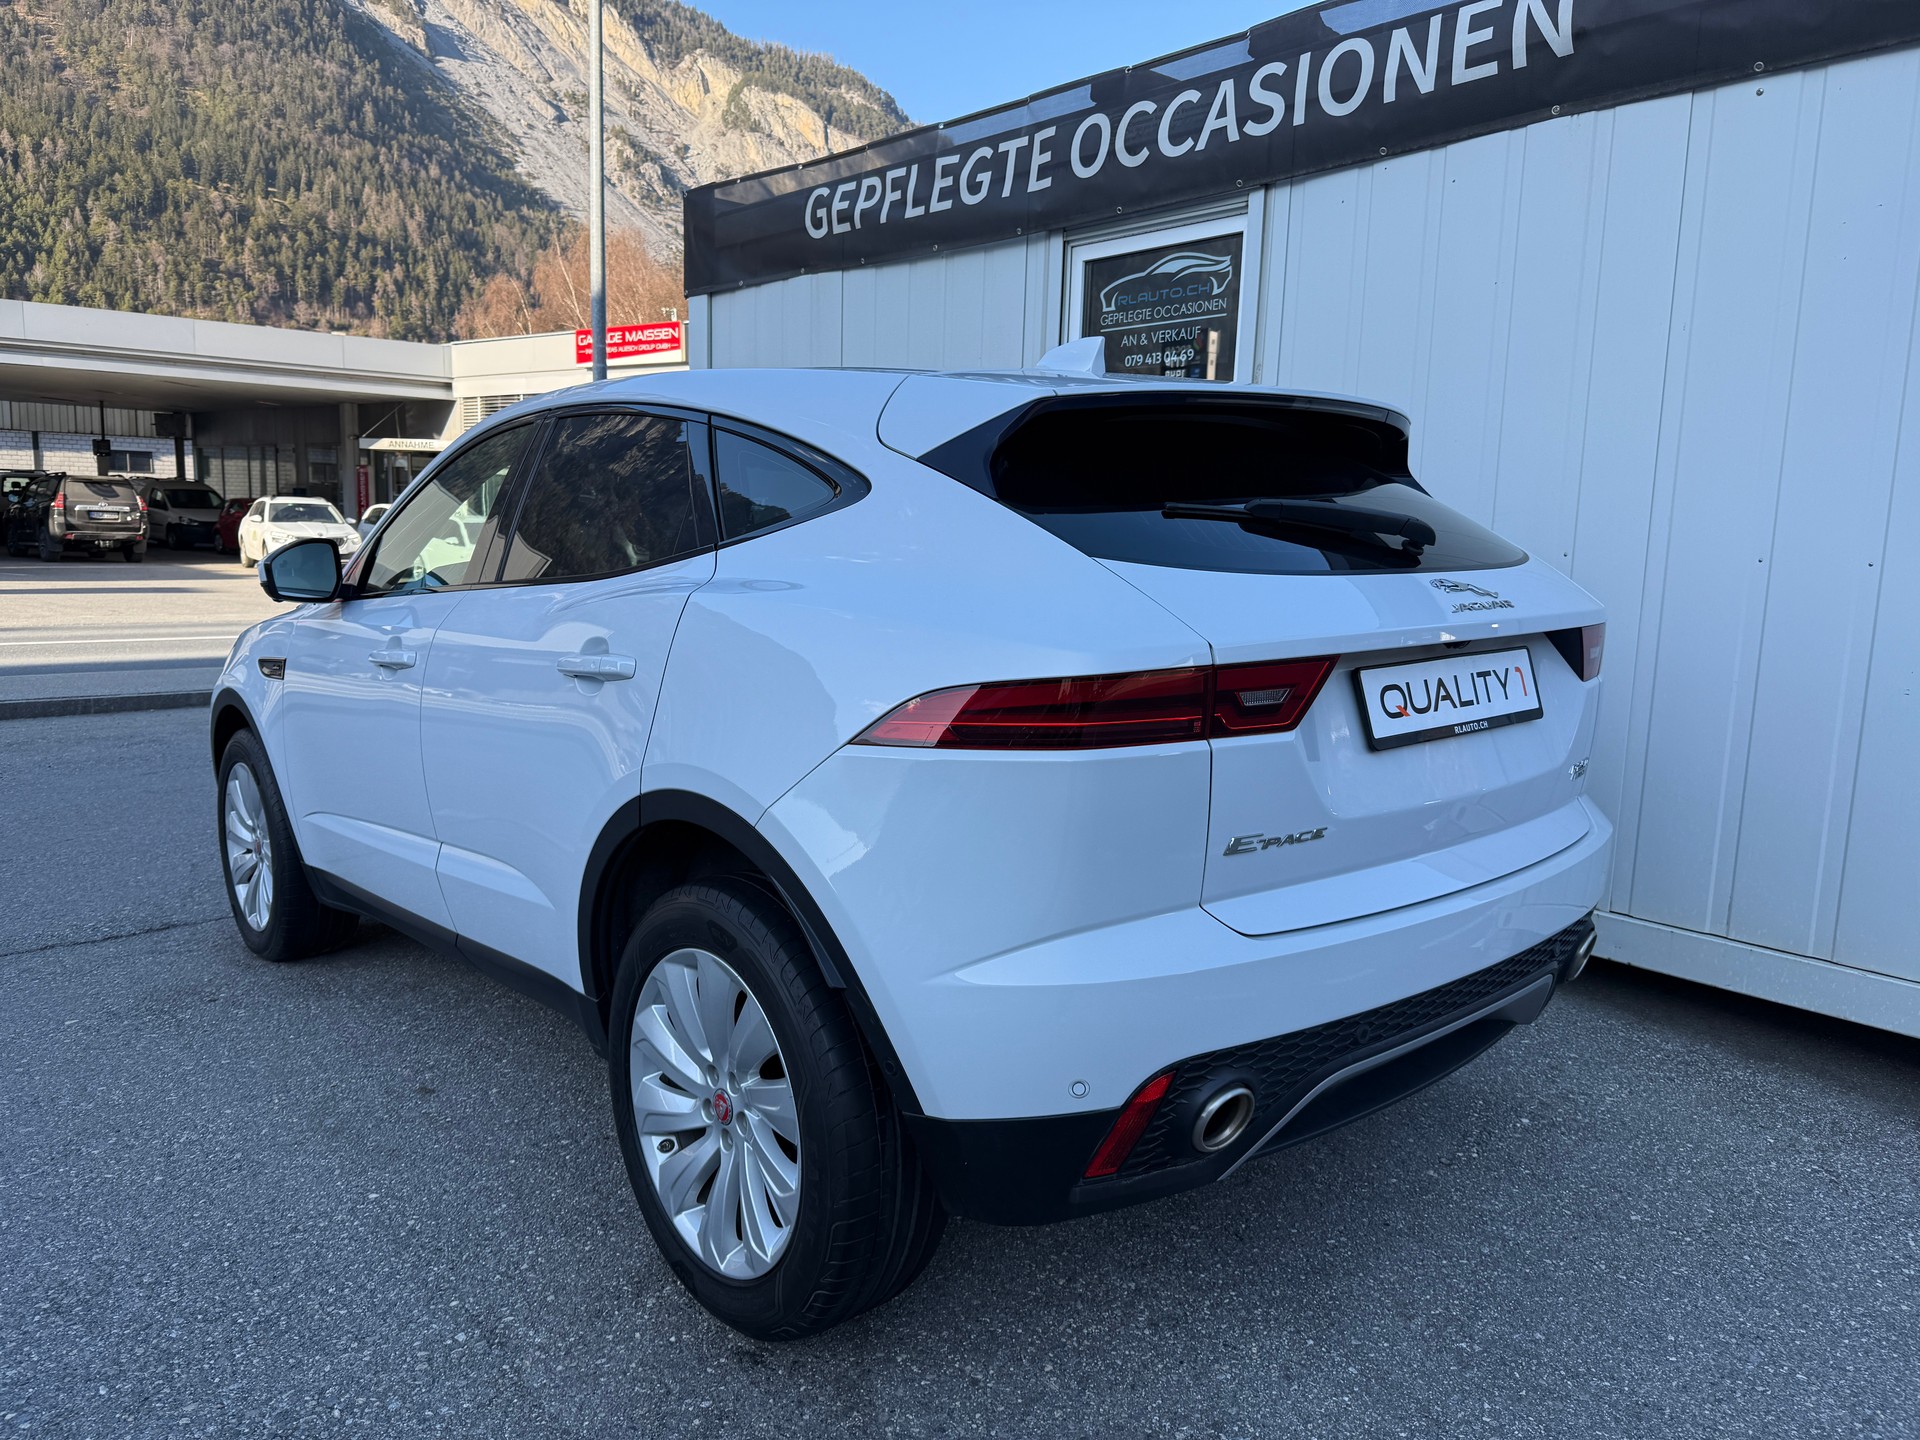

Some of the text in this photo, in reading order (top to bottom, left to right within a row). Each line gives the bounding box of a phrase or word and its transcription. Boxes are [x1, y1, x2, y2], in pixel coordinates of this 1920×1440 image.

[804, 0, 1575, 239] GEPFLEGTE OCCASIONEN
[1117, 282, 1210, 306] RLAUTO.CH
[1100, 298, 1228, 326] GEPFLEGTE OCCASIONEN
[577, 327, 679, 346] GAGE MAISSEN
[1120, 326, 1202, 348] AN & VERKAUF
[1124, 354, 1143, 368] 079
[1145, 352, 1162, 365] 413
[1163, 350, 1178, 363] 04
[1180, 348, 1195, 361] 69
[388, 440, 435, 449] ANNAHME
[1451, 599, 1515, 614] JAGUAR
[1454, 720, 1489, 735] RLAUTO.CH
